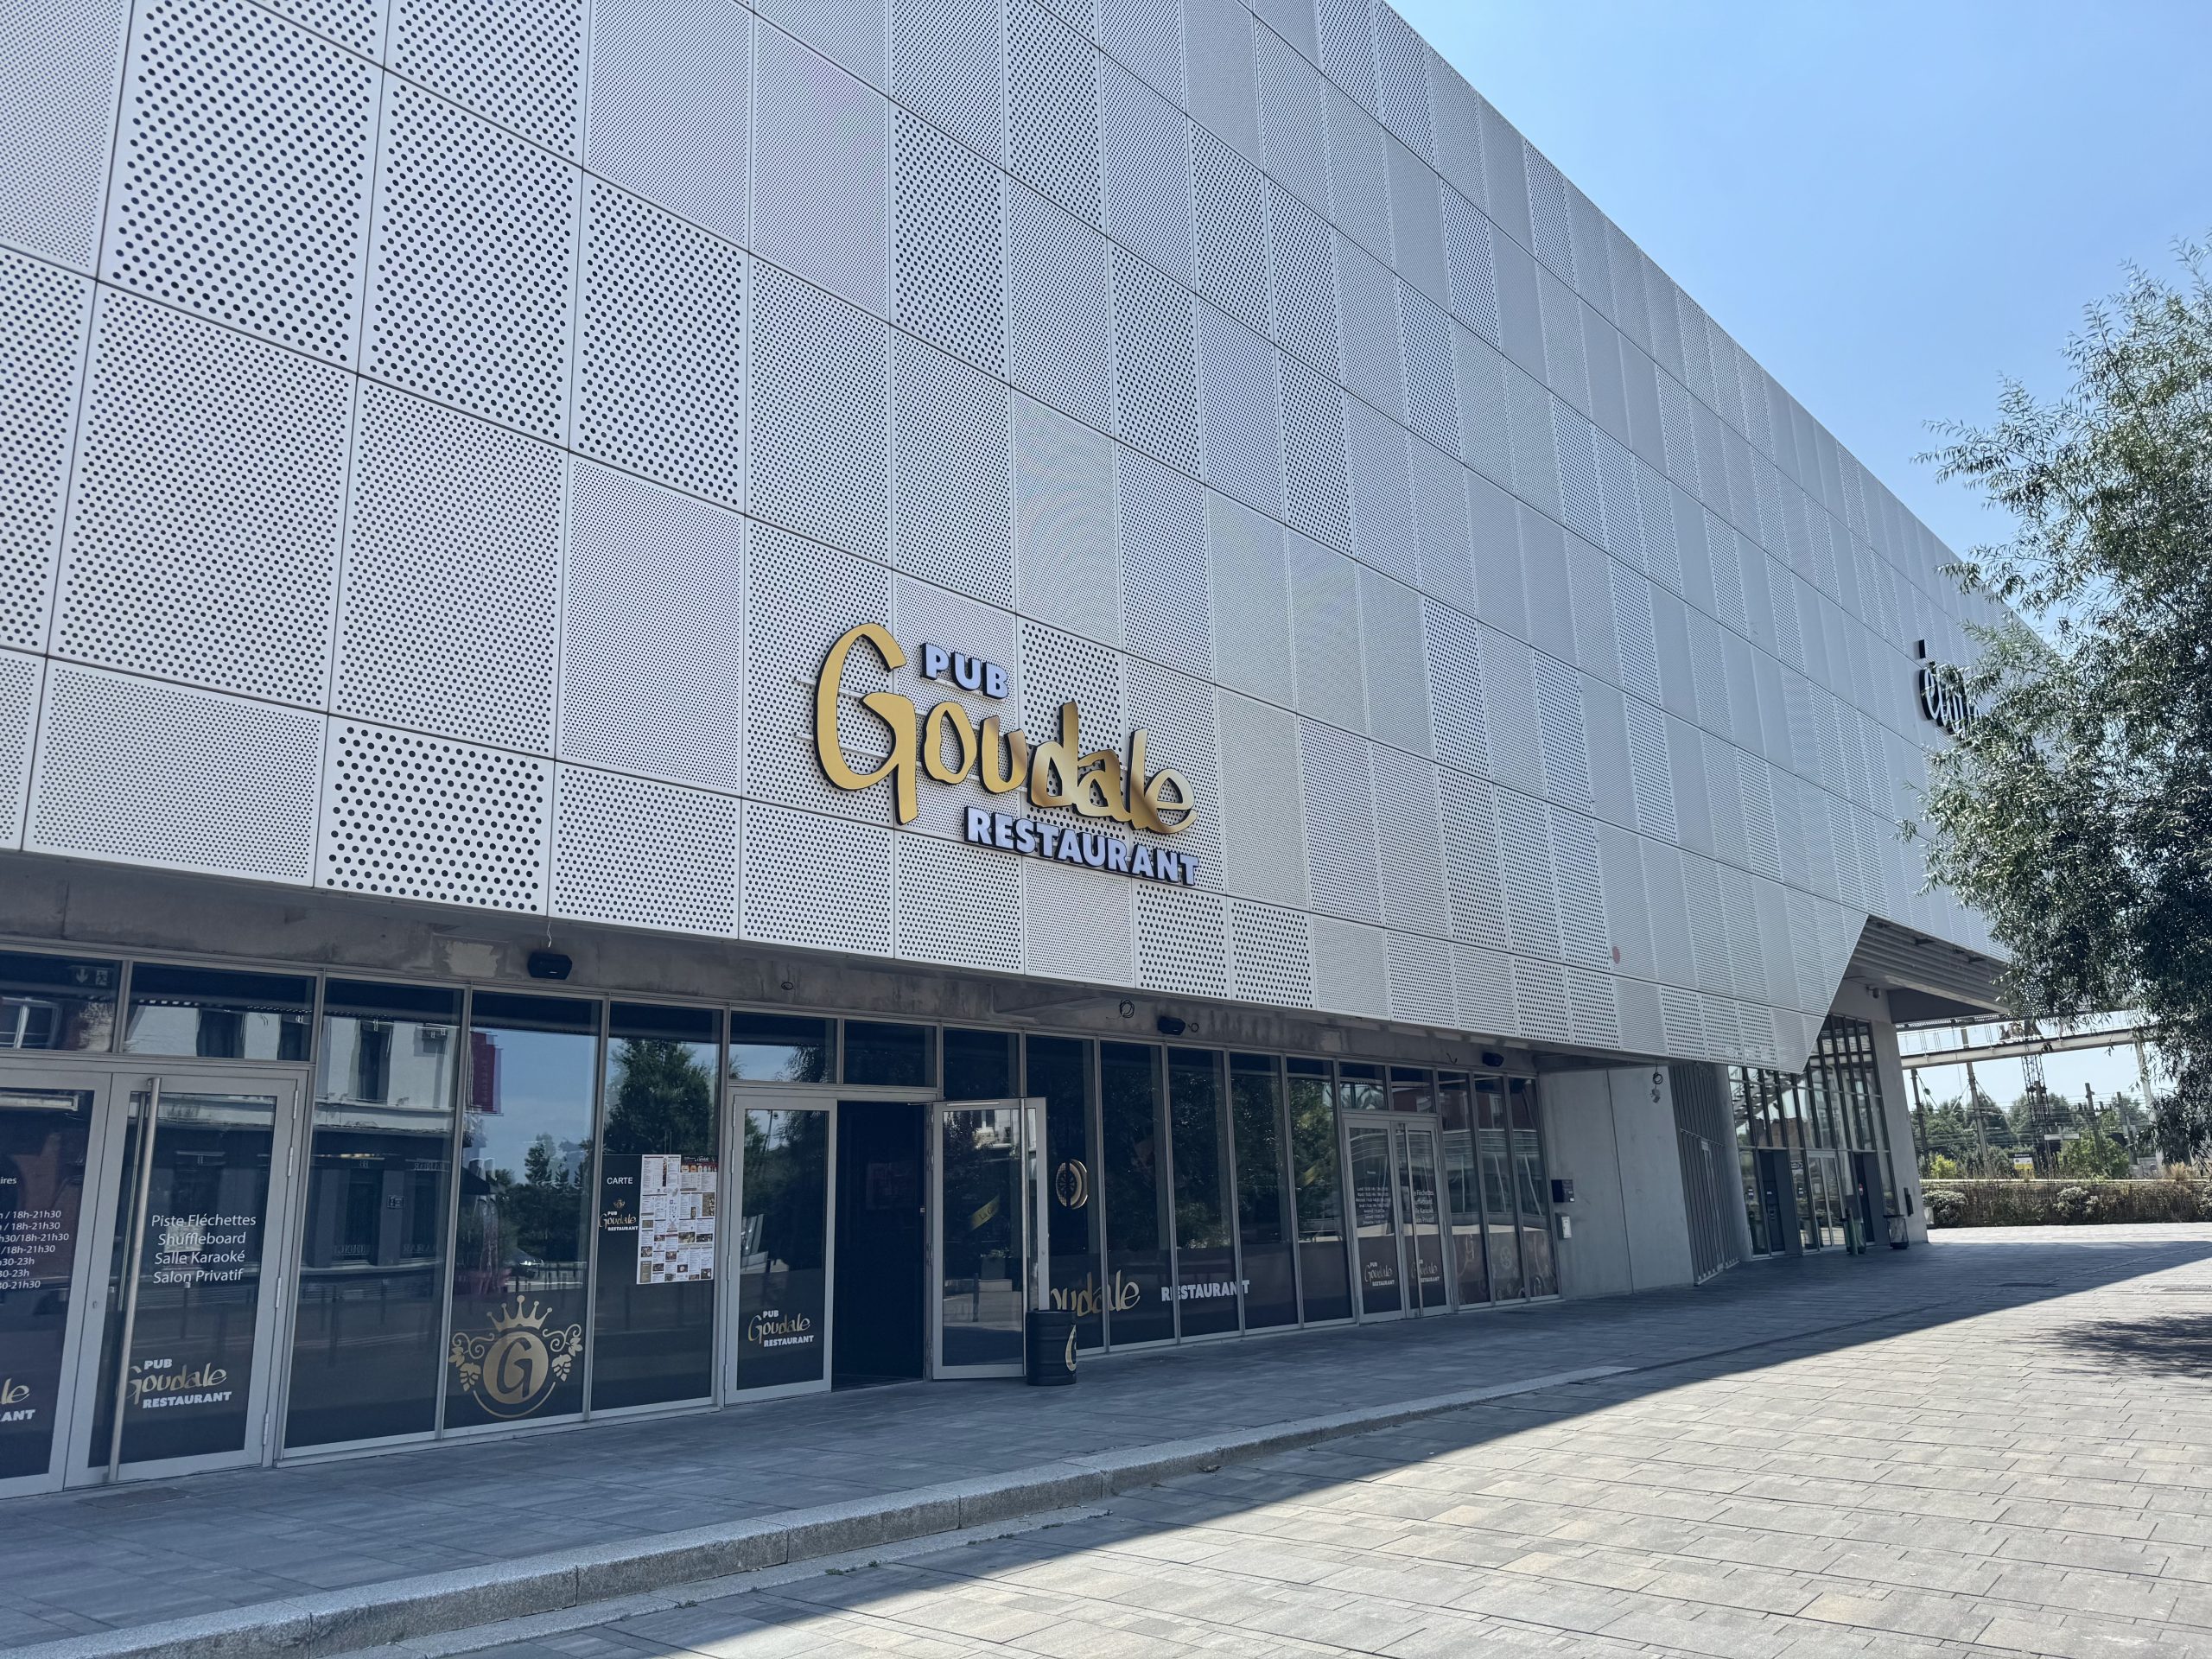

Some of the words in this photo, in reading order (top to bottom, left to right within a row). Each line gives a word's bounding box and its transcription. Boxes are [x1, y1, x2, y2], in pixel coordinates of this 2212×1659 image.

[920, 642, 1009, 699] PUB
[813, 622, 1198, 835] Goudale
[964, 805, 1199, 887] RESTAURANT
[12, 1210, 61, 1219] 18h-21h30
[151, 1215, 185, 1227] Piste
[188, 1213, 257, 1226] Fléchettes
[11, 1222, 60, 1230] 18h-21h30
[157, 1231, 246, 1246] Shuffleboard
[155, 1252, 188, 1265] Salle
[191, 1249, 245, 1264] Karaoké
[153, 1271, 192, 1284] Salon
[195, 1268, 245, 1282] Privatif
[762, 1310, 779, 1319] PUB
[747, 1313, 810, 1344] Goudale
[763, 1335, 815, 1348] RESTAURANT
[143, 1358, 173, 1370] PUB
[143, 1391, 232, 1409] RESTAURANT
